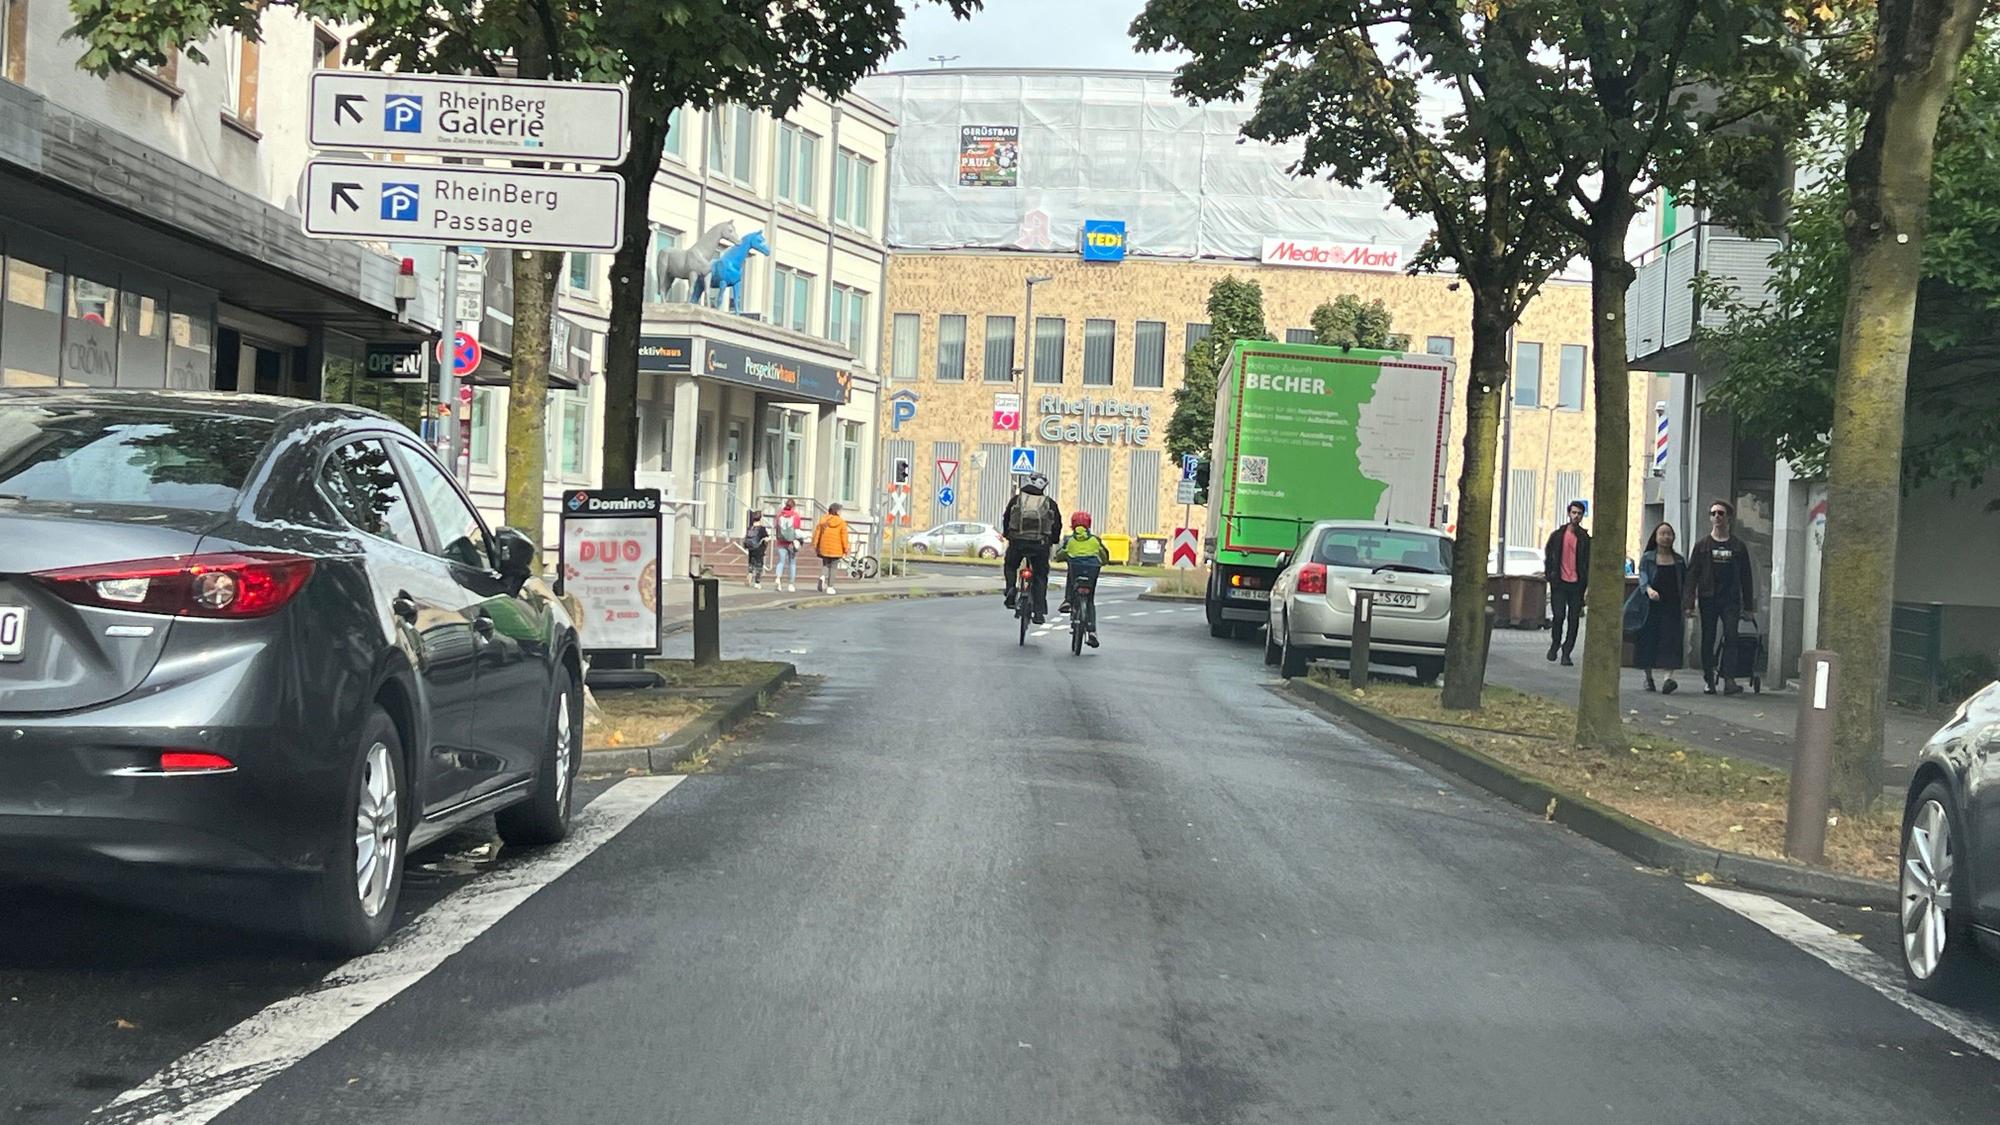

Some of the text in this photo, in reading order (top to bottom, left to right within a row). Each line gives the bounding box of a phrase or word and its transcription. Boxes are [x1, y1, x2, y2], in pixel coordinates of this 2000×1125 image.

[439, 91, 545, 119] RheinBerg
[438, 110, 545, 137] Galerie
[961, 157, 991, 168] PAUL
[435, 179, 558, 211] RheinBerg
[433, 209, 533, 238] Passage
[1086, 232, 1122, 247] TEDi
[1268, 241, 1398, 267] Media Markt
[744, 355, 797, 385] Perspektivhaus
[1040, 394, 1152, 424] RheinBerg
[1039, 414, 1151, 446] Galerie
[588, 497, 656, 511] Domino's
[579, 539, 642, 563] DUO
[1393, 594, 1412, 605] 499
